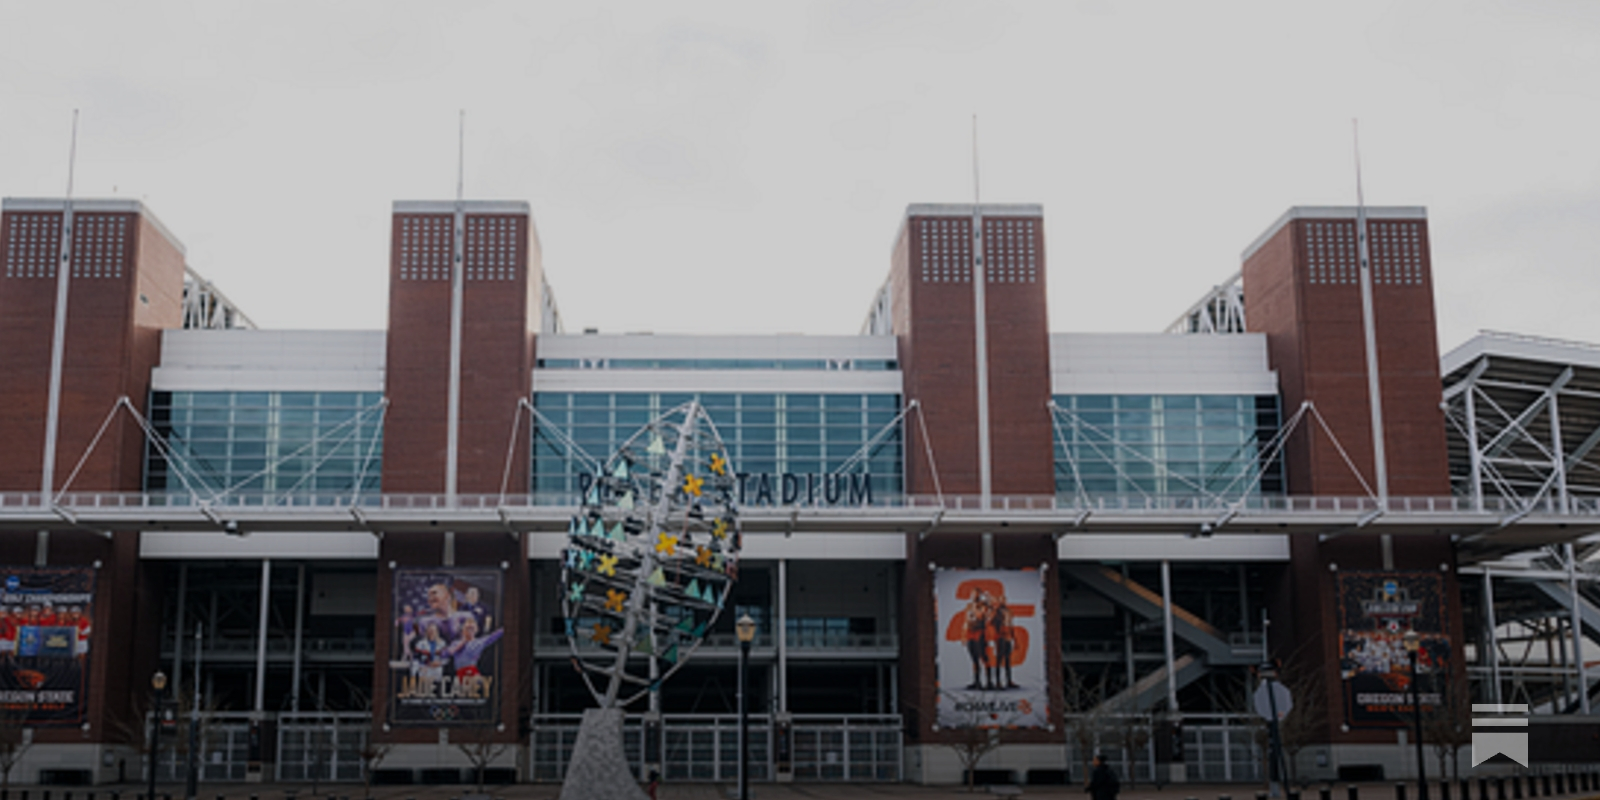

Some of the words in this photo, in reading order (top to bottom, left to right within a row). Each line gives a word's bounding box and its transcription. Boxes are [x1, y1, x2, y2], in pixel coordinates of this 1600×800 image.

[397, 676, 437, 698] JADE
[441, 676, 493, 698] CAREY
[37, 690, 74, 703] STATE
[1357, 693, 1405, 704] OREGON
[1407, 693, 1441, 705] SATE
